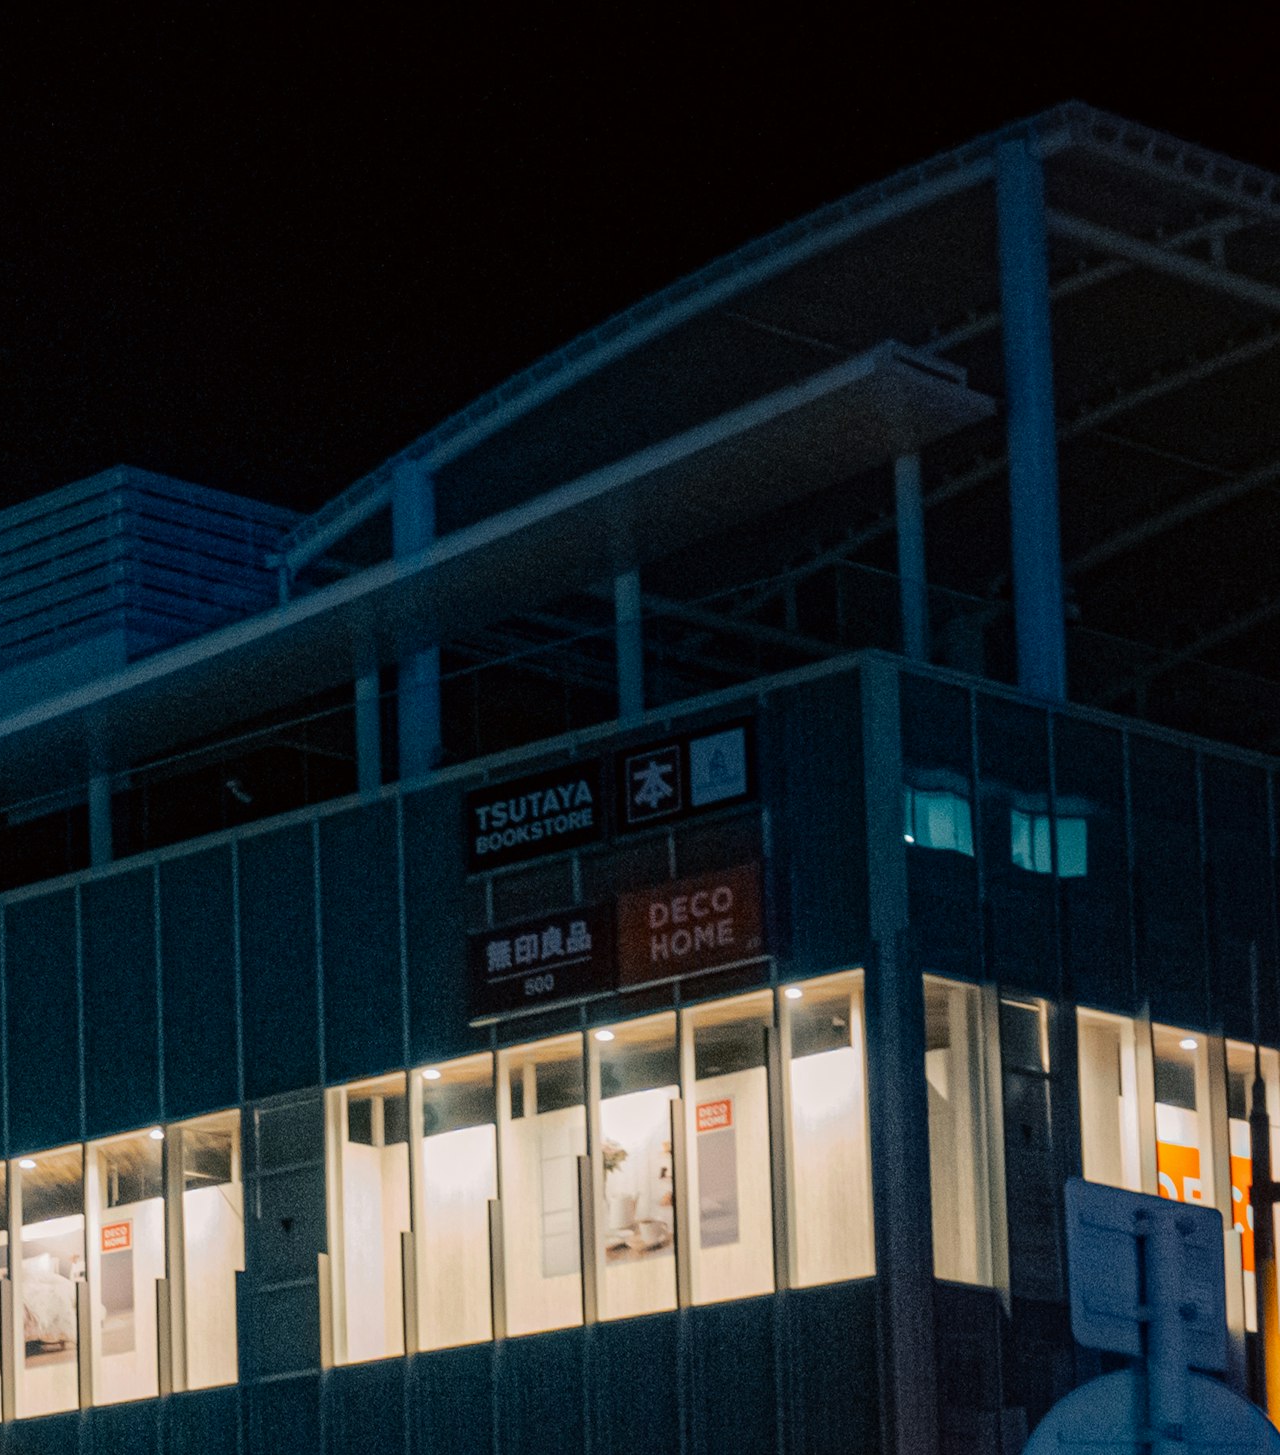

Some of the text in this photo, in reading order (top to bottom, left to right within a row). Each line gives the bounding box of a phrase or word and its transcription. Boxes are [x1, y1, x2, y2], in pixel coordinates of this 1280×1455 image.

[475, 780, 593, 830] TSUTAYA
[633, 761, 673, 808] 本
[476, 808, 593, 854] BOOKSTORE
[649, 886, 734, 929] DECO
[488, 919, 592, 972] 無印良品
[650, 918, 735, 962] HOME
[699, 1103, 728, 1118] DECO
[103, 1226, 128, 1239] DECO
